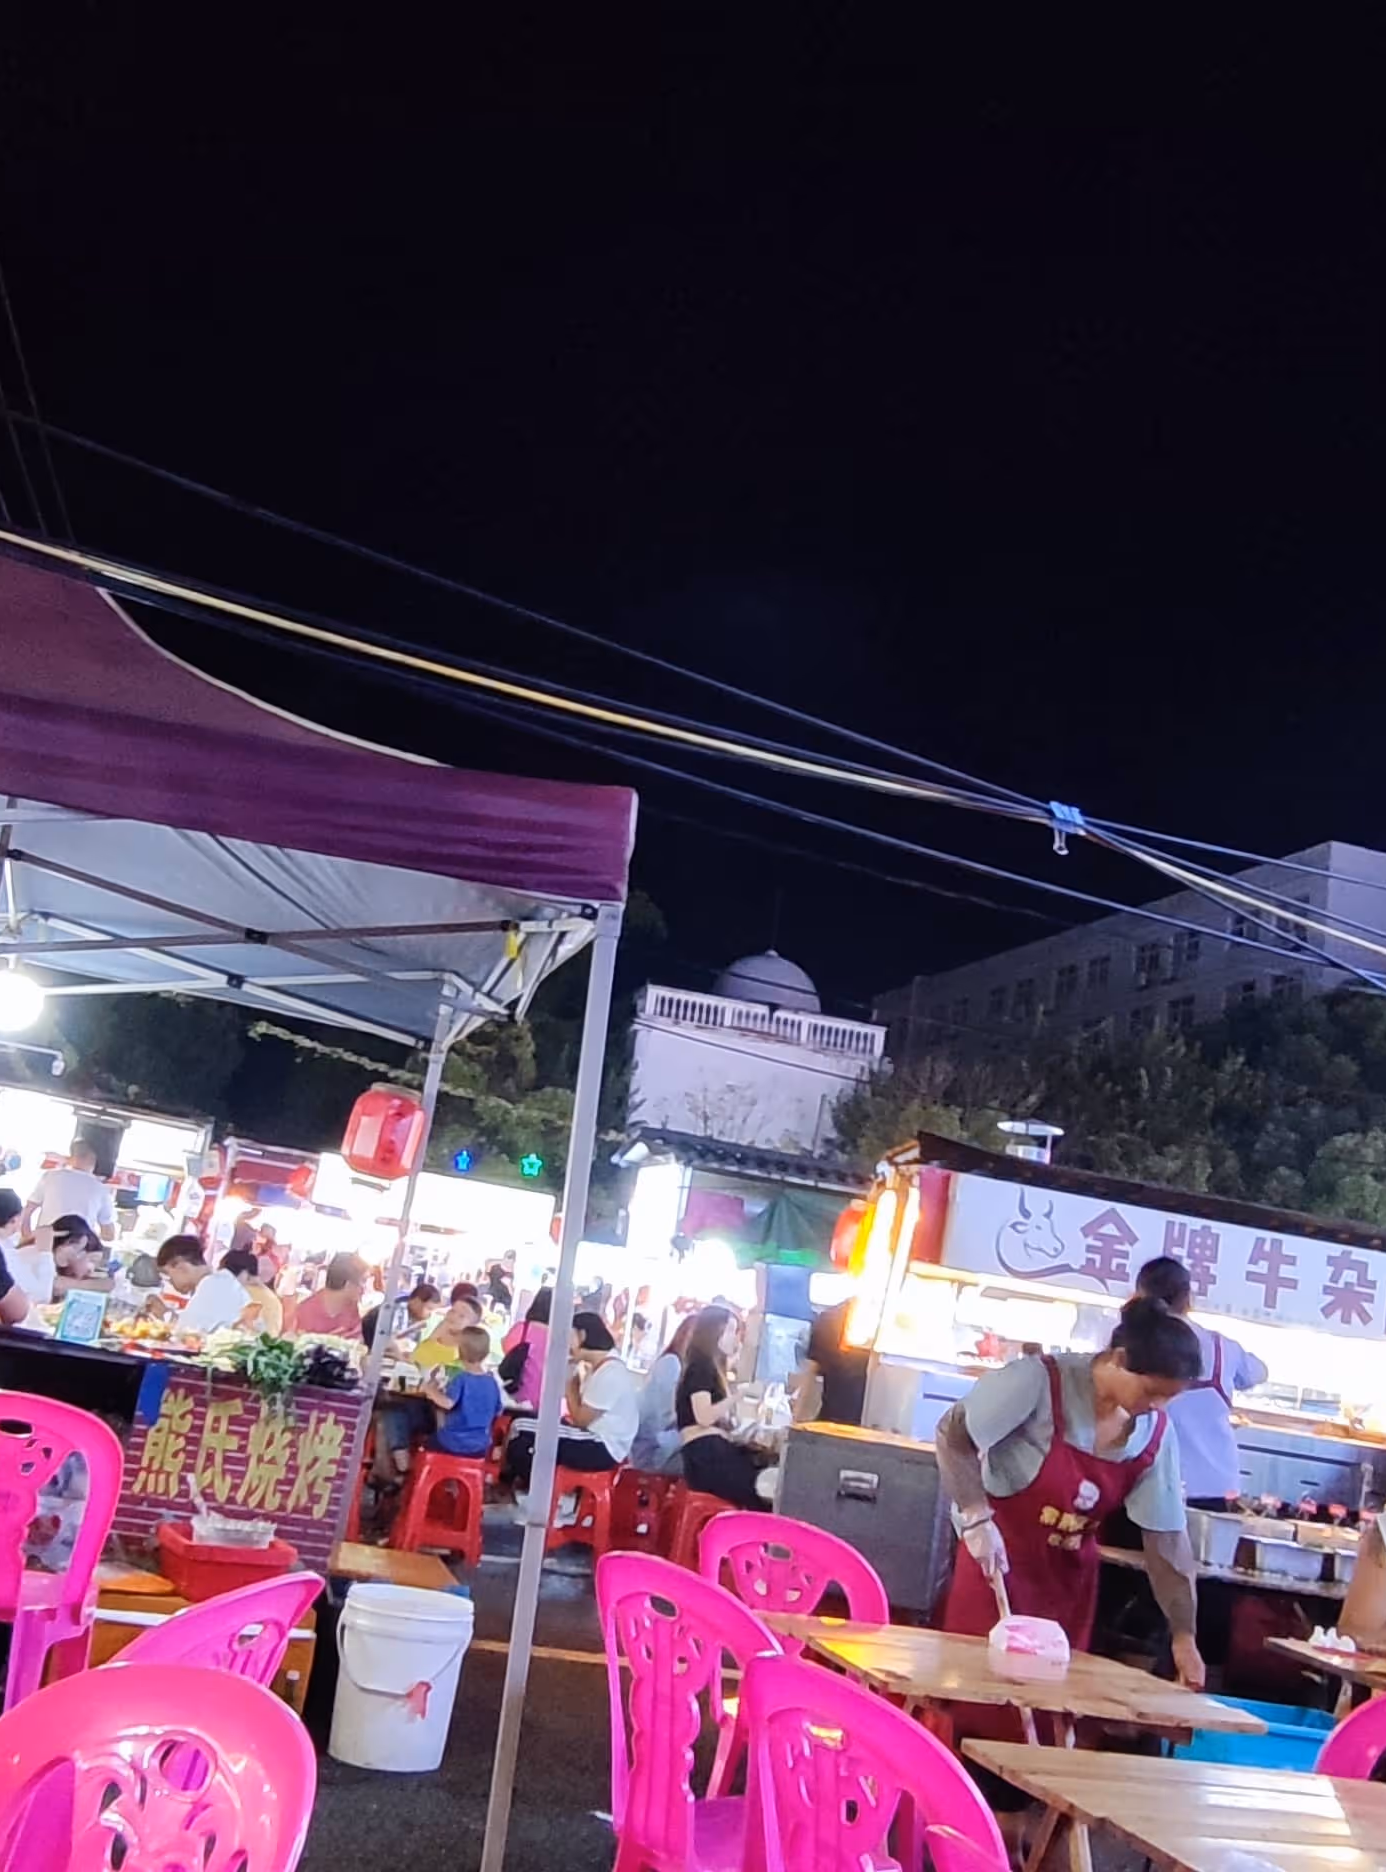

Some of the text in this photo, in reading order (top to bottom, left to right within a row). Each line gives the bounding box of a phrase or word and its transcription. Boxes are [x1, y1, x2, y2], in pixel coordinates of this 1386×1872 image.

[1078, 1207, 1377, 1327] 金牌牛杂
[132, 1386, 346, 1521] 熊氏烧烤
